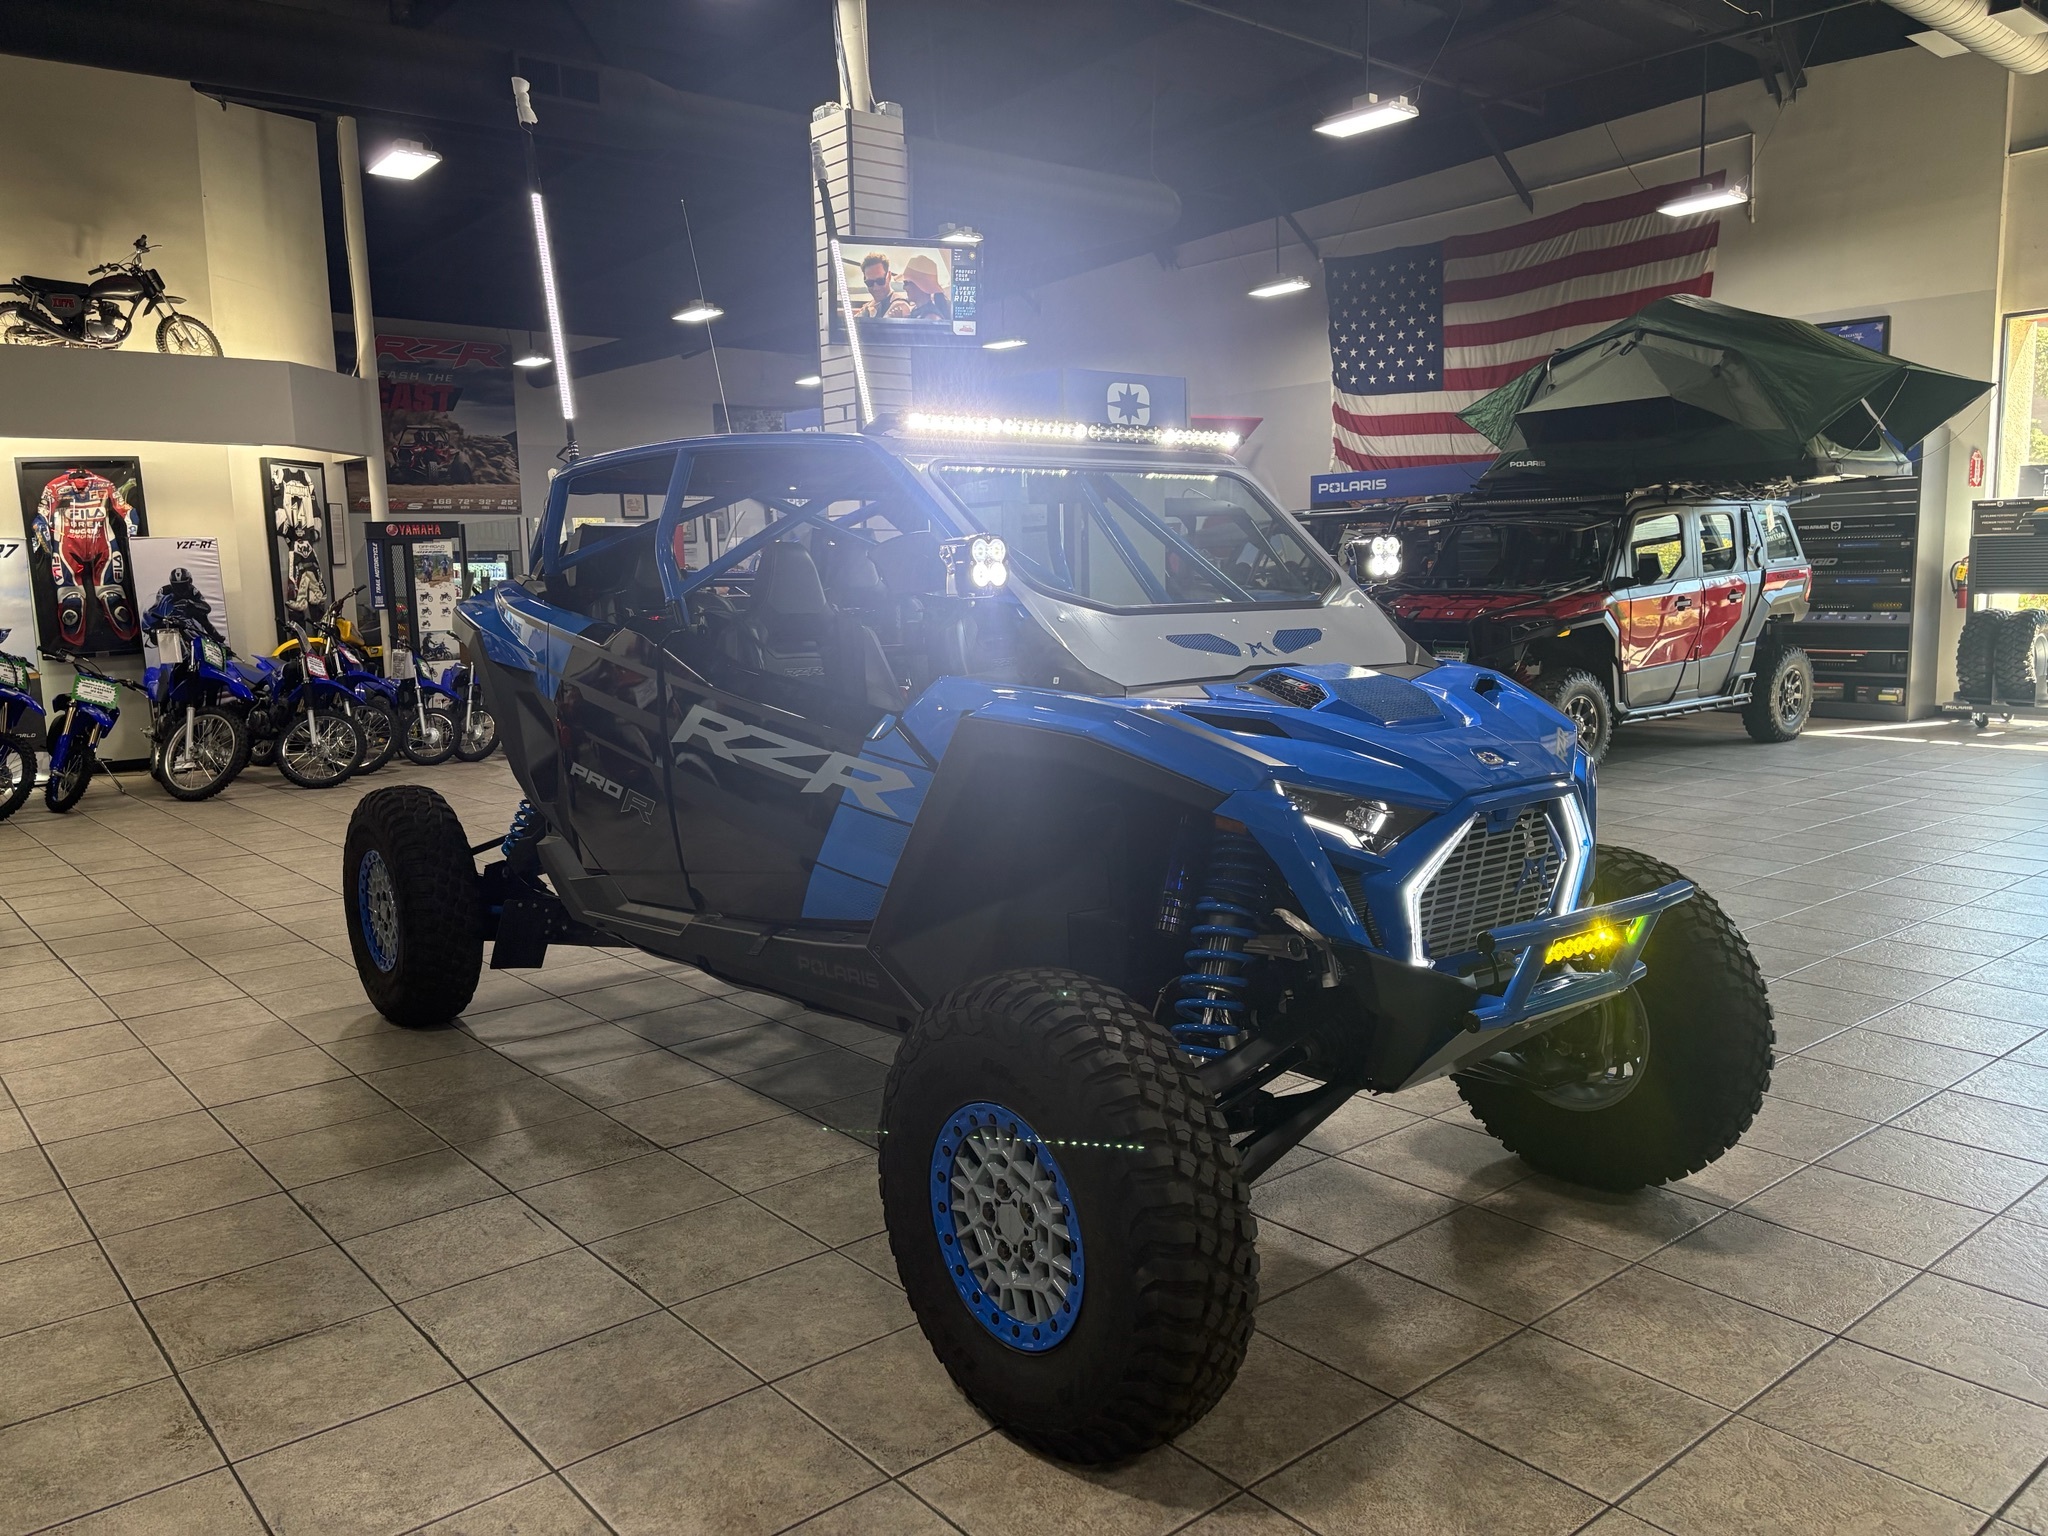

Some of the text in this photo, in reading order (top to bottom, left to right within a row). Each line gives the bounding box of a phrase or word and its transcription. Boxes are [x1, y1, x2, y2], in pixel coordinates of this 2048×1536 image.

[375, 334, 506, 370] RZR
[427, 373, 454, 382] THE
[381, 382, 454, 413] EAST
[1509, 460, 1546, 468] POLARIS
[1318, 478, 1387, 494] POLARIS
[70, 507, 105, 518] FILA
[400, 524, 441, 536] YAMAHA
[176, 540, 212, 550] YZF-R1
[112, 554, 123, 580] FILA
[372, 542, 381, 578] MOTORCYCLE
[783, 666, 825, 677] RZR
[671, 704, 915, 818] RZR
[570, 761, 657, 826] PRO R
[798, 956, 880, 990] POLARIS
